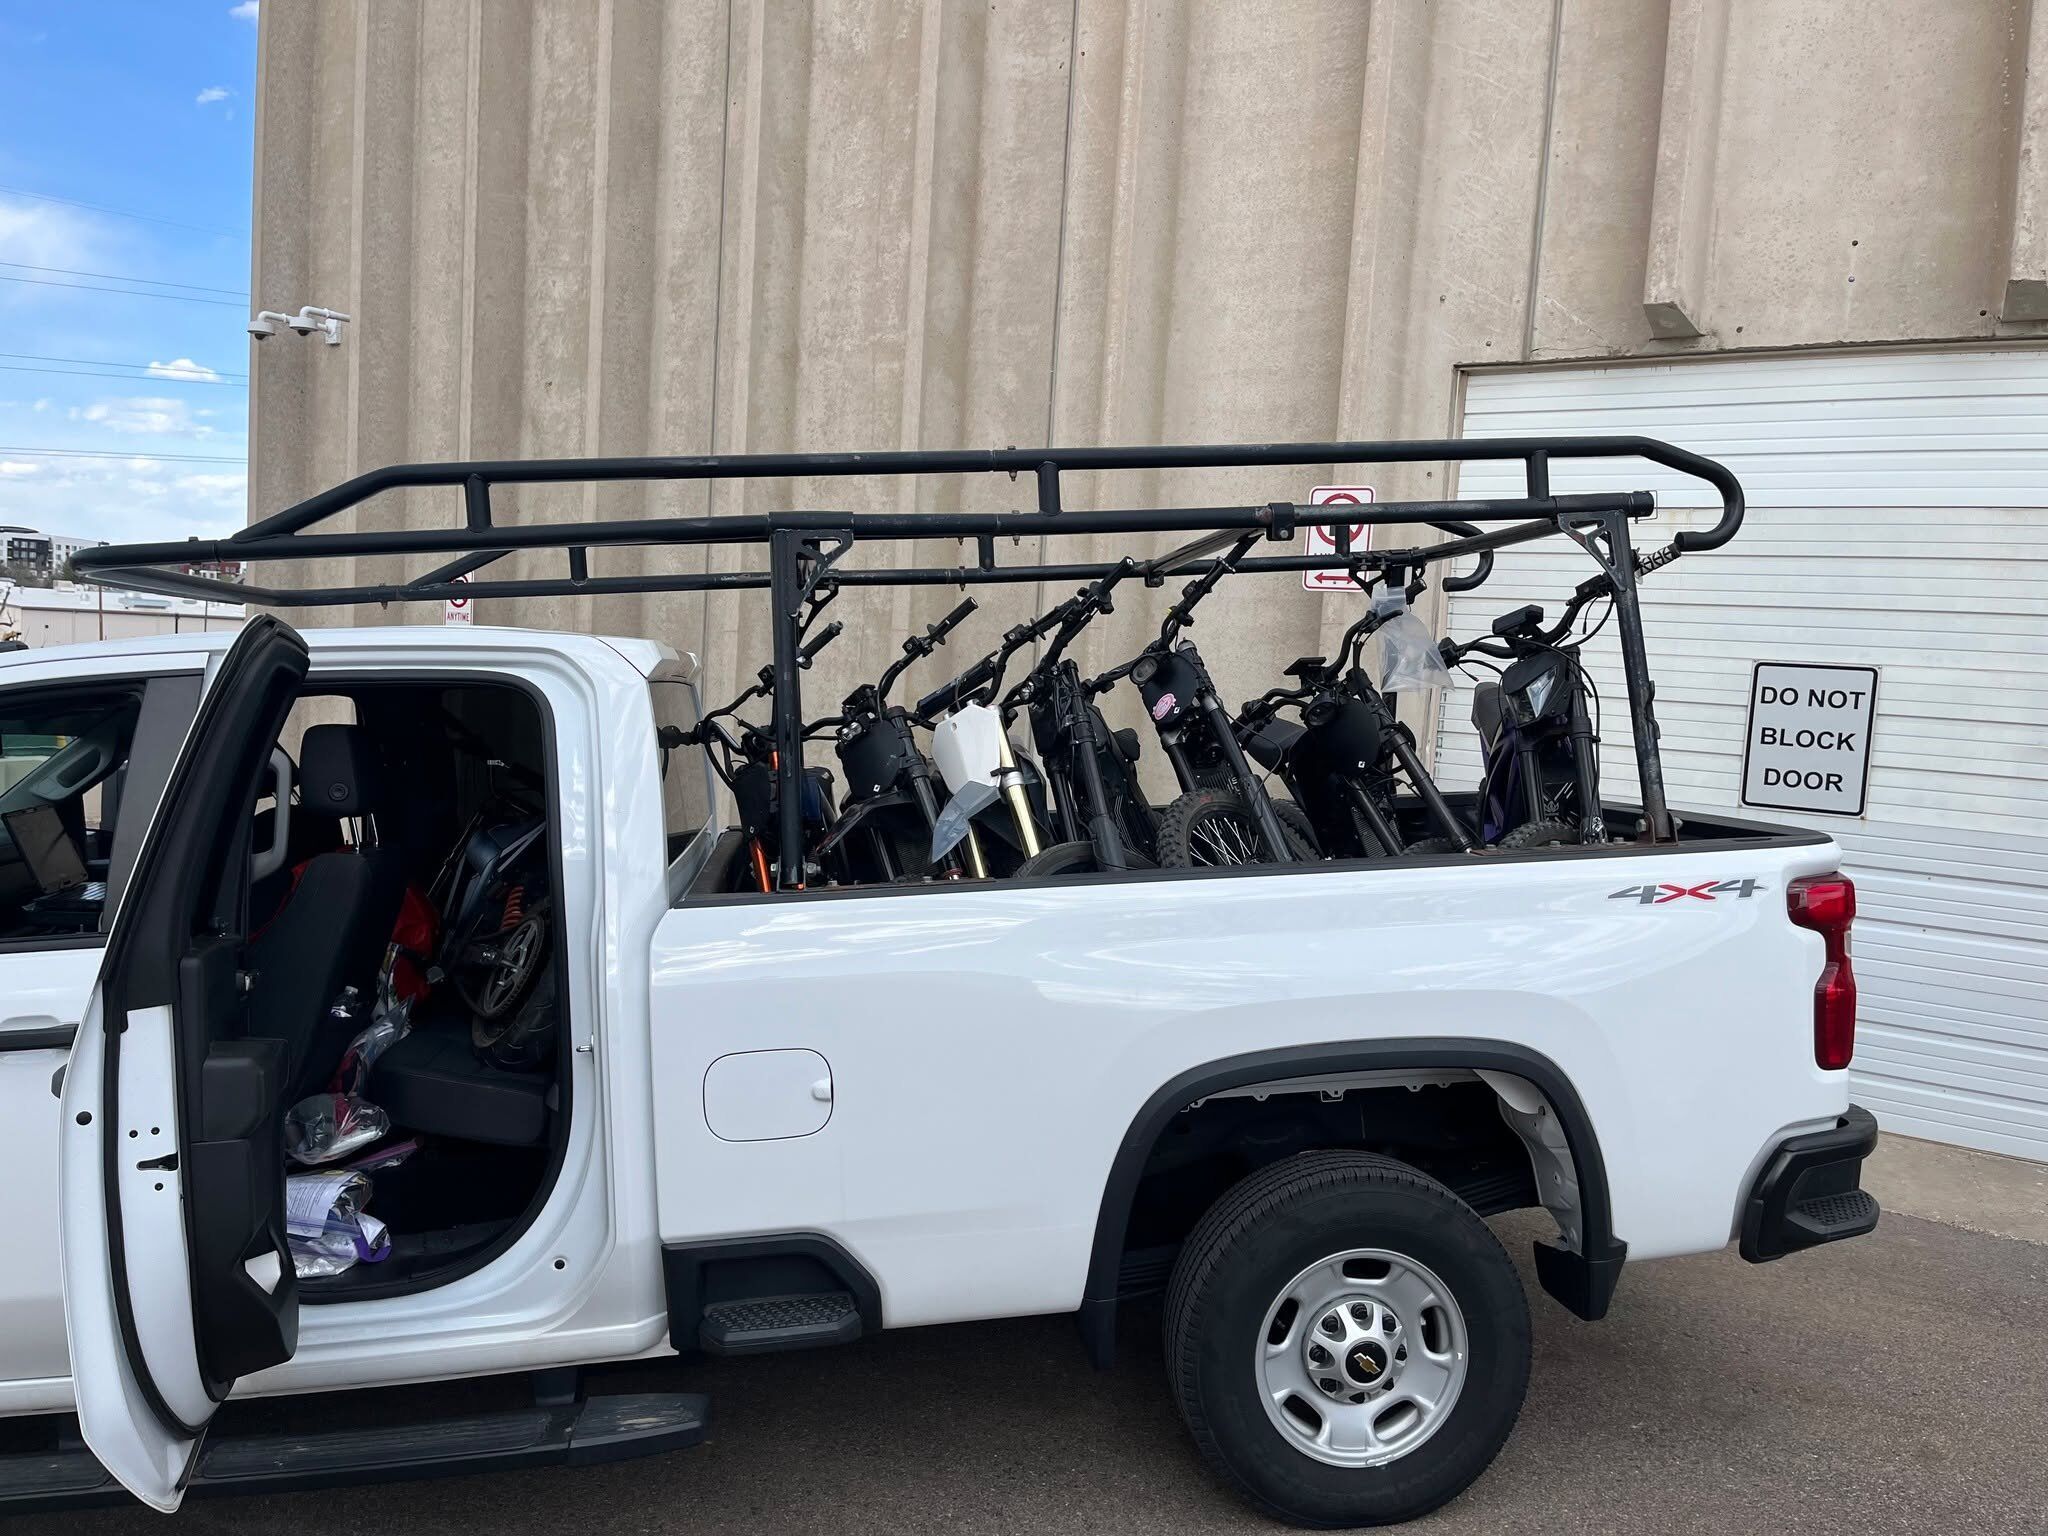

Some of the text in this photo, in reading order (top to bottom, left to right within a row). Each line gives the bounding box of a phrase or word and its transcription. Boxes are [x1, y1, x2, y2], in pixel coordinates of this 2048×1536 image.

[1760, 686, 1866, 710] DO NOT
[1760, 727, 1856, 752] BLOCK
[1763, 768, 1843, 792] DOOR
